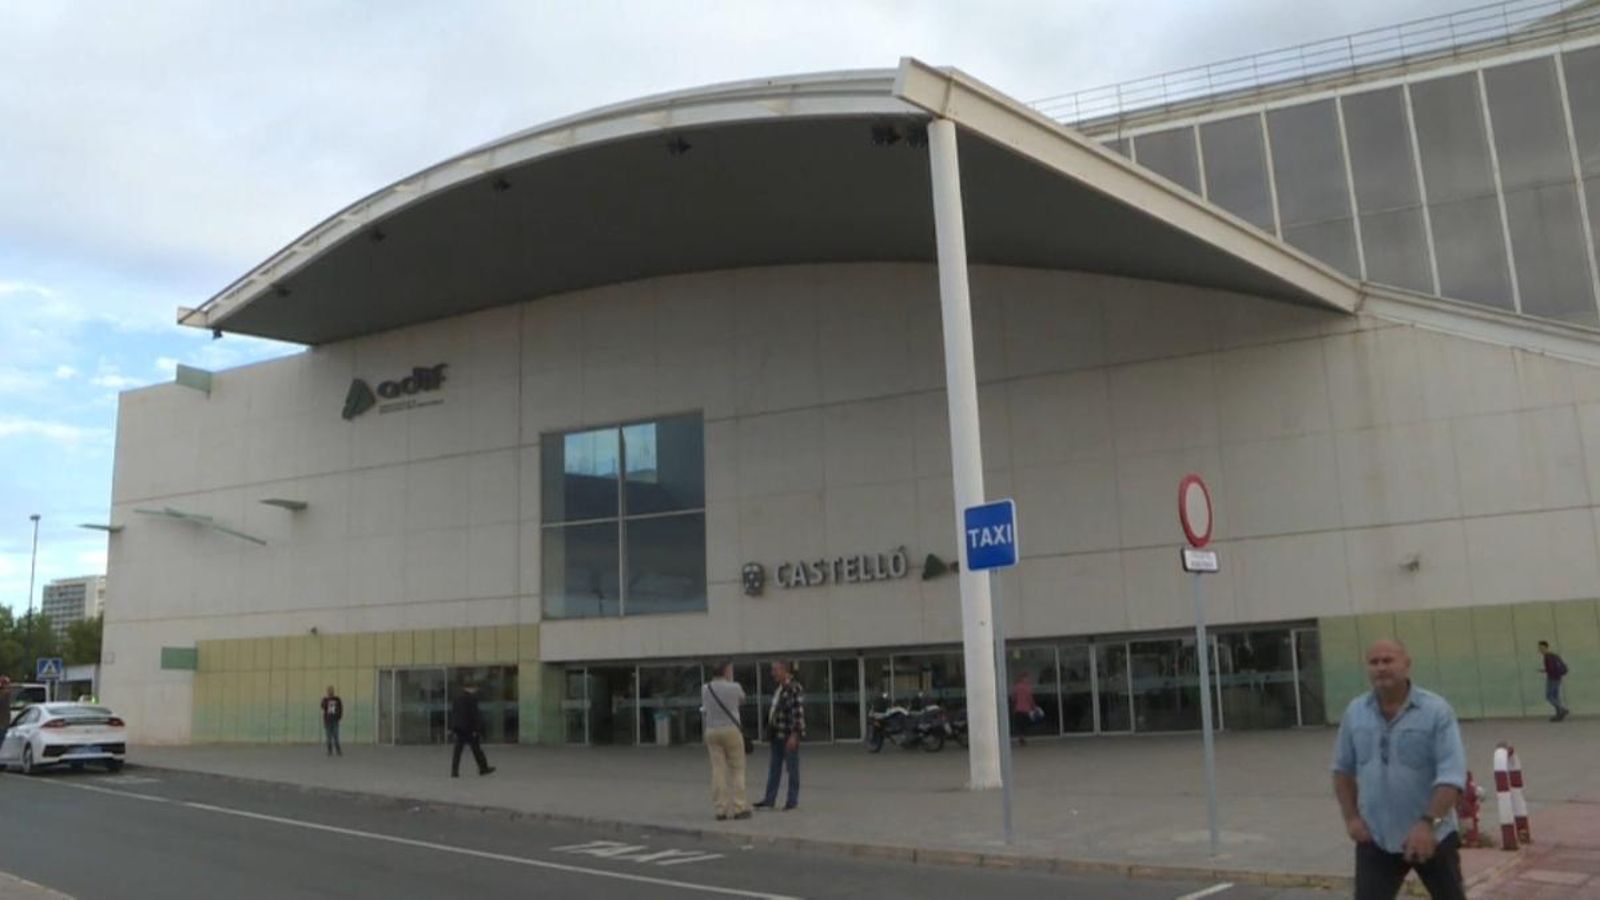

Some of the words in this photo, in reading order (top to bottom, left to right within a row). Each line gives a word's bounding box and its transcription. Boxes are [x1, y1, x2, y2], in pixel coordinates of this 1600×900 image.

[377, 363, 448, 399] adif
[967, 523, 1012, 549] TAXI
[774, 546, 907, 590] CASTELLÓ
[549, 840, 726, 866] TAXI
